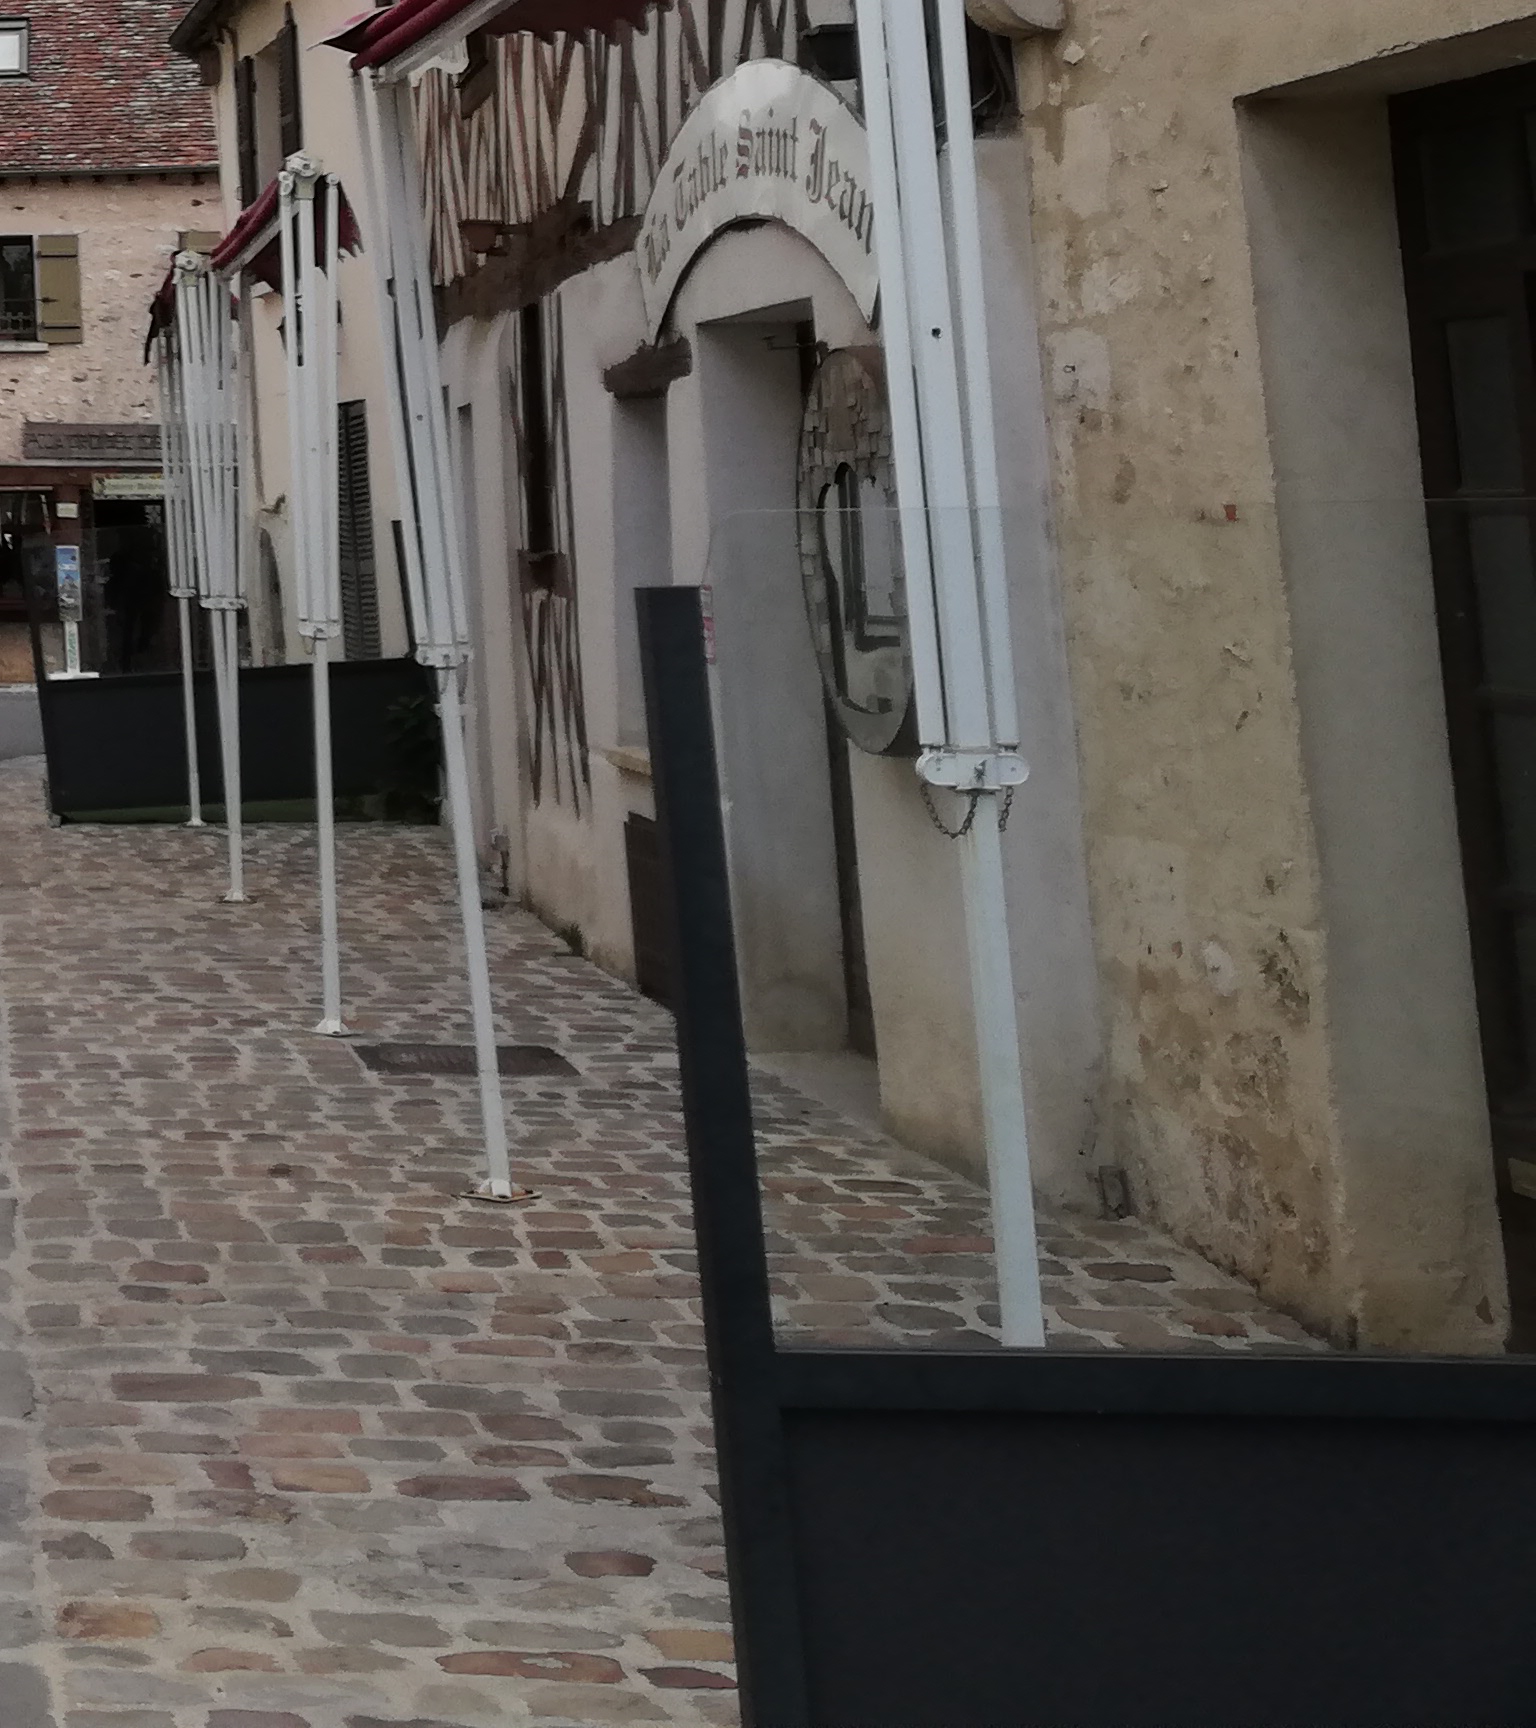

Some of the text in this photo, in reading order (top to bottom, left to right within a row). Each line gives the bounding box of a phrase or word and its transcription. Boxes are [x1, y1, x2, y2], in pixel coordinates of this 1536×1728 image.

[672, 128, 729, 232] Table
[734, 107, 799, 183] Saint
[804, 116, 875, 256] Jean
